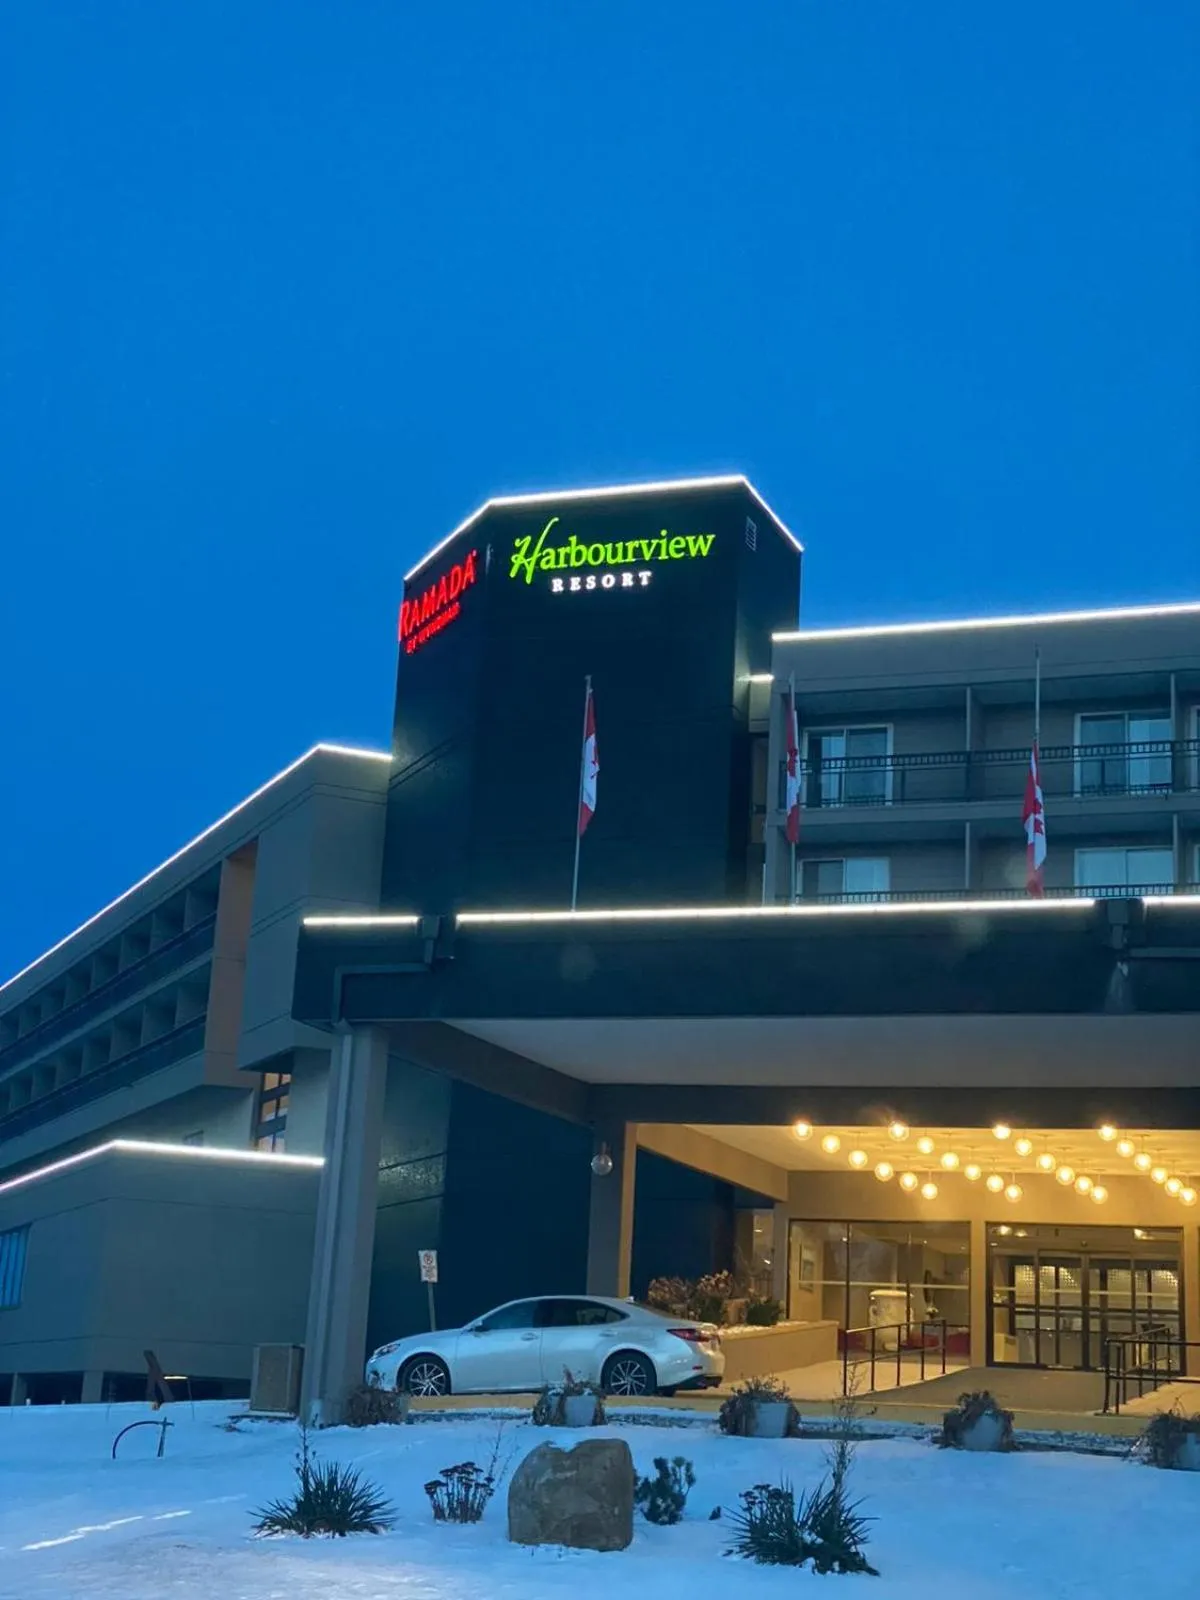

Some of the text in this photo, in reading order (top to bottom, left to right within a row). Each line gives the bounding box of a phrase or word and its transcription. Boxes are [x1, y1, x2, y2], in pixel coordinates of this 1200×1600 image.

[509, 517, 715, 584] Harbourview
[551, 571, 653, 592] RESORT
[398, 551, 476, 641] RAMADA
